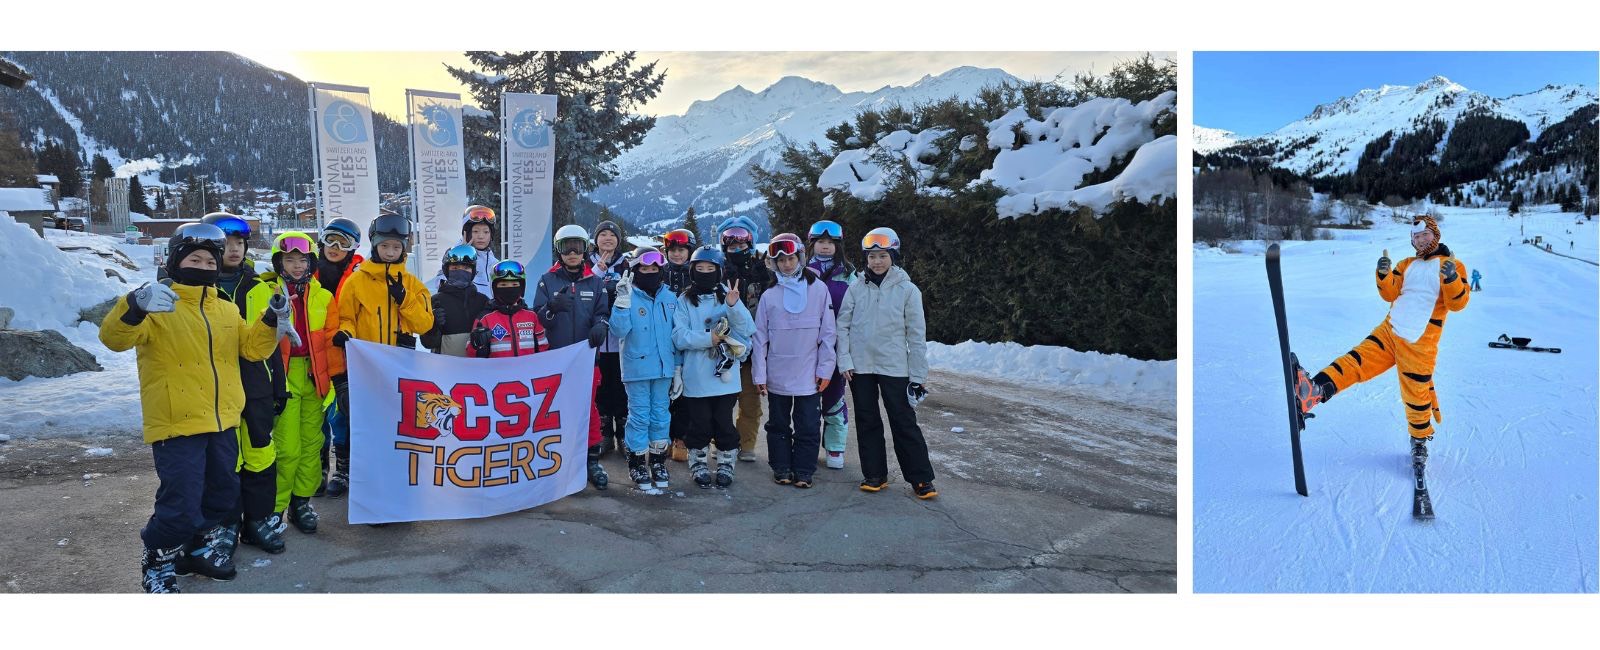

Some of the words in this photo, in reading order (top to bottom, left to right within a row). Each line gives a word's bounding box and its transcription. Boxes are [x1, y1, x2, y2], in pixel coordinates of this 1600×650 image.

[341, 155, 356, 194] ELFES
[355, 156, 369, 177] LES
[435, 159, 448, 195] ELFES
[448, 159, 459, 179] LES
[524, 160, 534, 195] ELFES
[536, 160, 547, 179] LES
[421, 158, 439, 261] INTERNATIONAL
[512, 162, 523, 258] INTERNATIONAL
[397, 373, 562, 441] DCSZ
[395, 435, 562, 488] TIGERS
